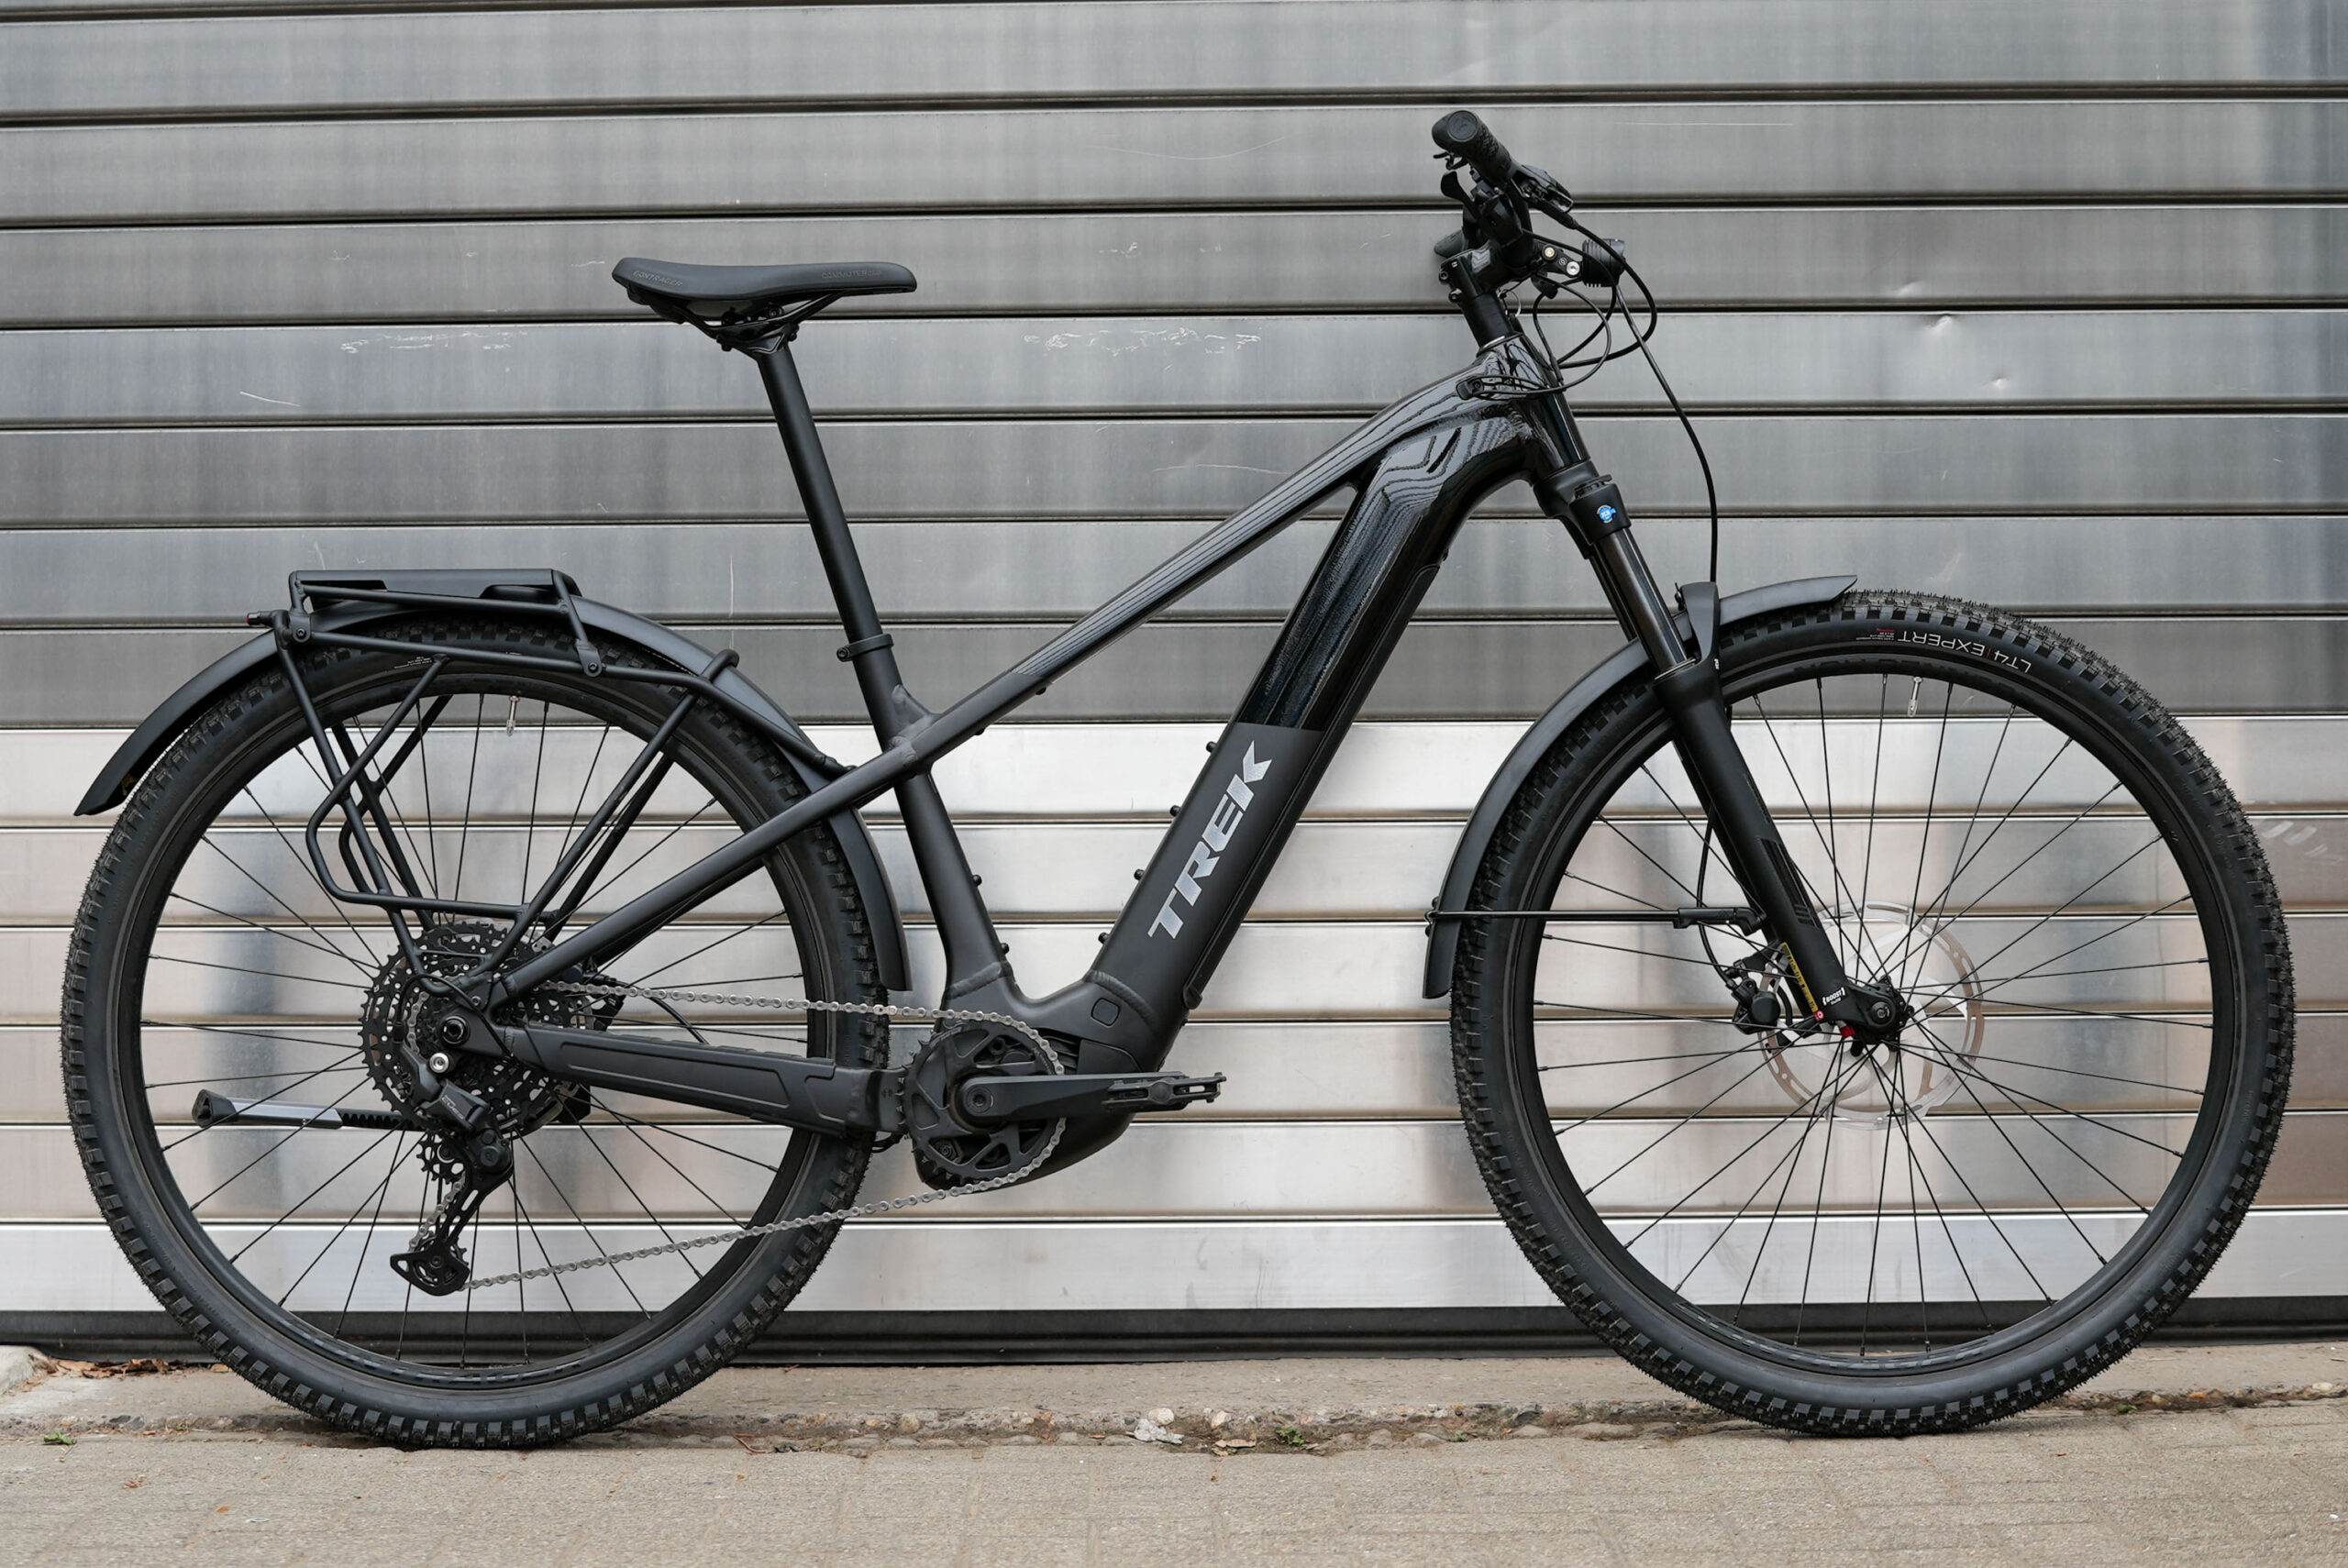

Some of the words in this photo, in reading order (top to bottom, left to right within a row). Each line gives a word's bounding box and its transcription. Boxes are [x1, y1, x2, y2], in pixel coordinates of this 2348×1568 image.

[1897, 630, 1986, 657] EXPERT
[1994, 649, 2032, 674] LT4
[1147, 740, 1273, 939] TREK
